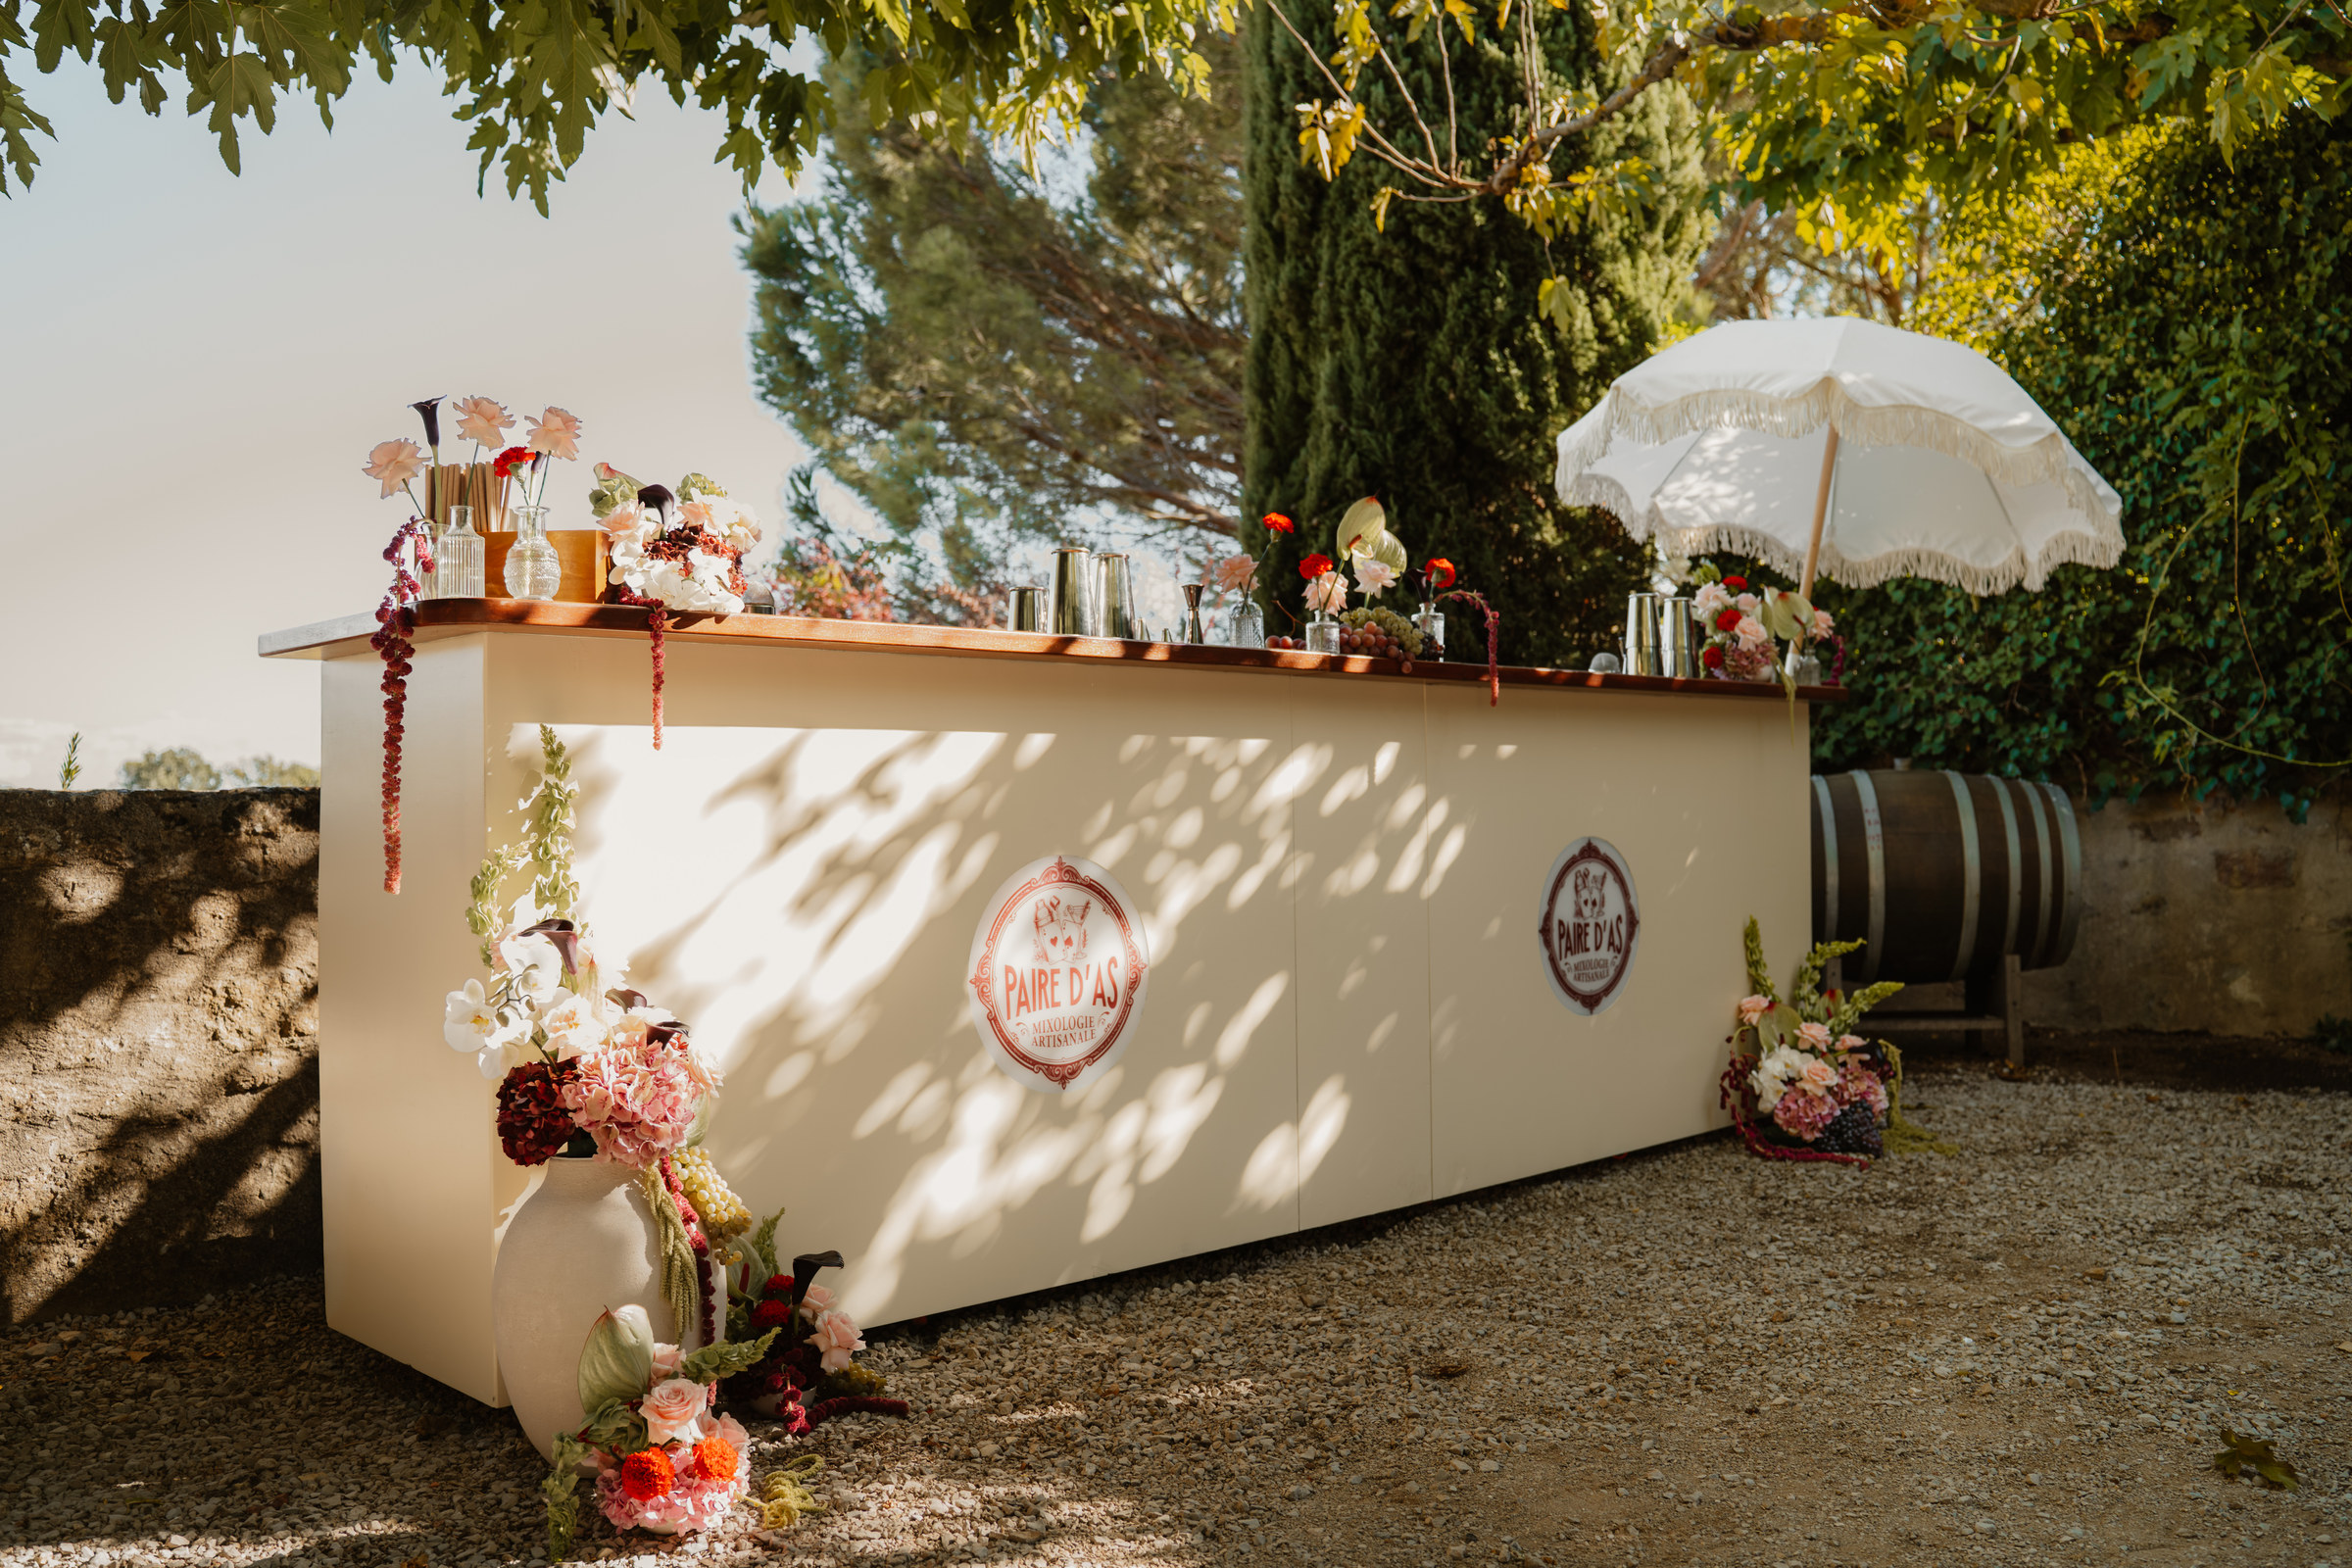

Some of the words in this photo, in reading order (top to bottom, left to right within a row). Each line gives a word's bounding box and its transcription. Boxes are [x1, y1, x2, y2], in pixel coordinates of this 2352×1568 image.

[1557, 919, 1590, 961] PAIRE
[1594, 913, 1623, 955] D'AS
[1573, 958, 1609, 972] MIXOLOGIE
[1573, 969, 1609, 983] ARTISANALE
[1004, 964, 1061, 1020] PAIRE
[1069, 956, 1118, 1009] D'AS
[1032, 1015, 1096, 1035] MIXOLOGIE
[1031, 1029, 1097, 1048] ARTISANALE
